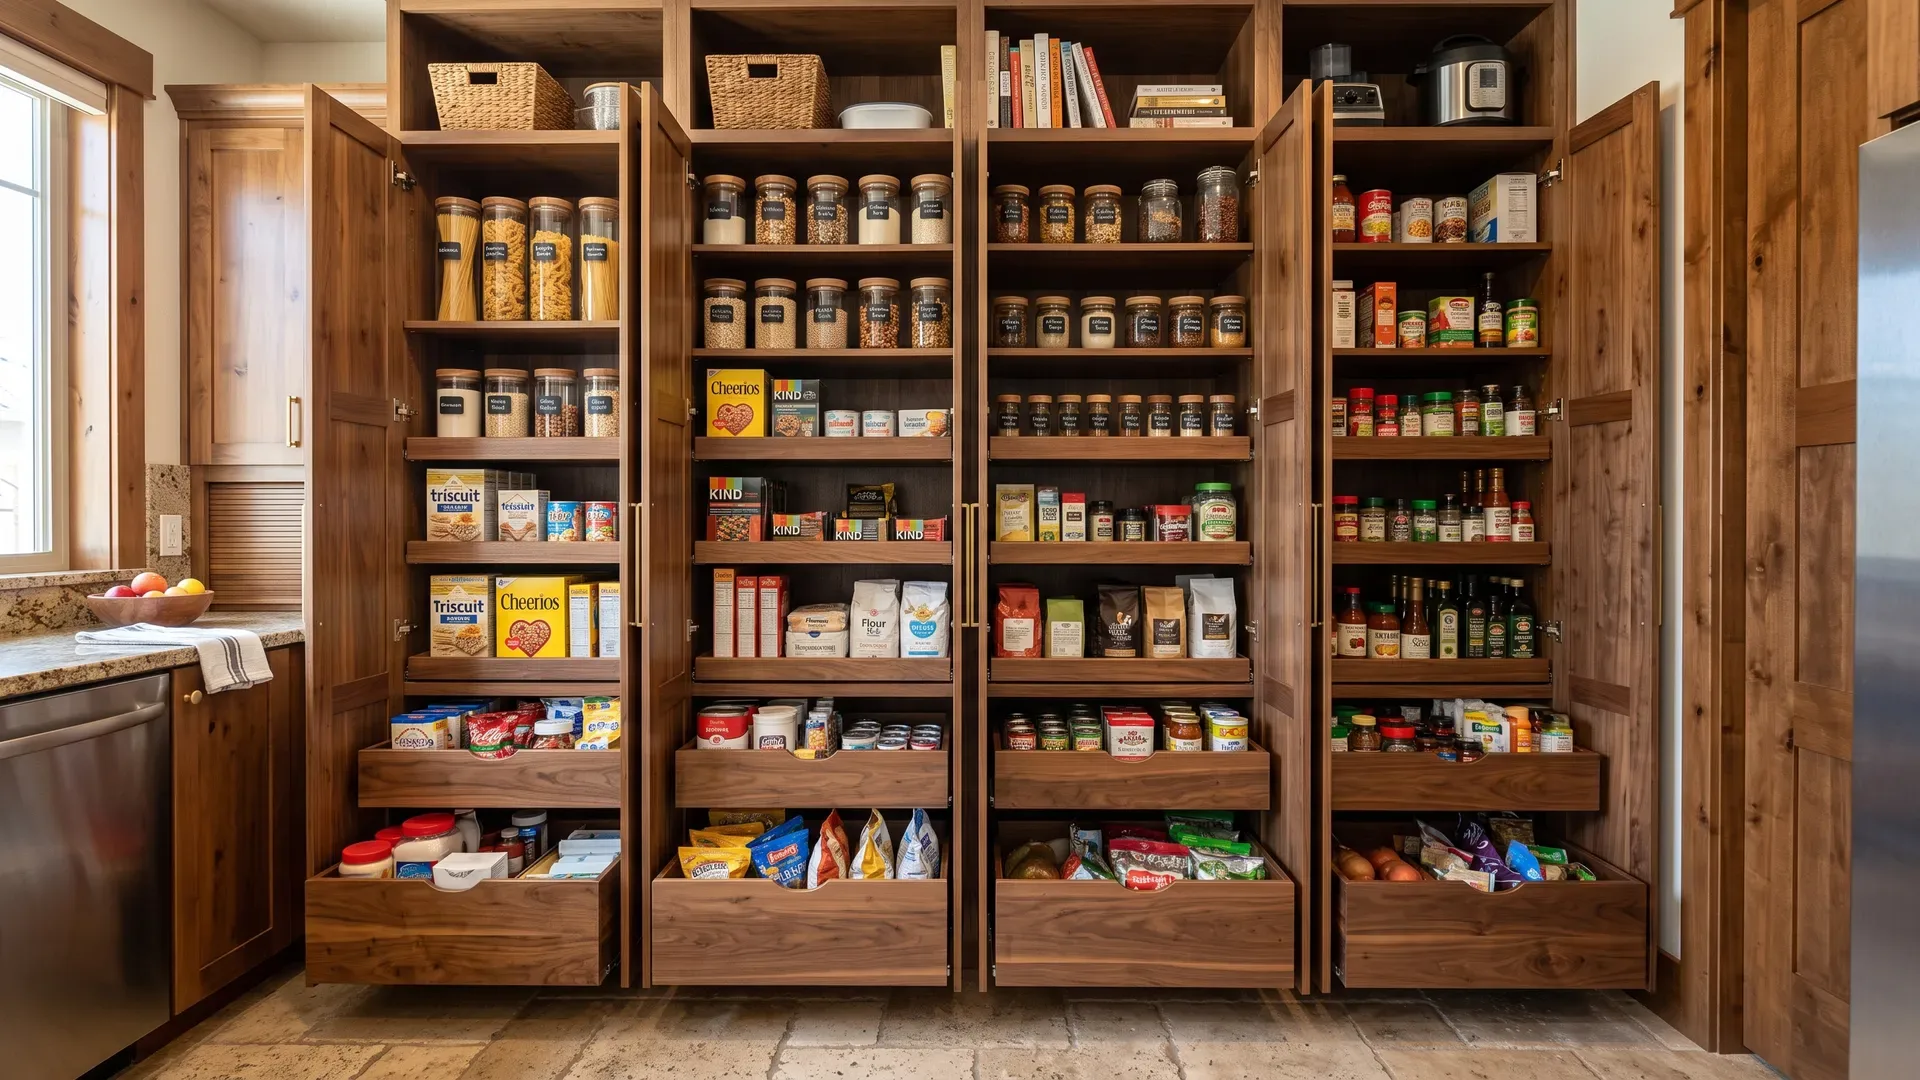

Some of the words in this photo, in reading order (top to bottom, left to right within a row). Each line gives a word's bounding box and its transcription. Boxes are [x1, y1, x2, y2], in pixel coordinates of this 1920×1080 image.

[711, 381, 760, 395] Cheerios
[774, 391, 802, 400] KIND
[430, 489, 480, 502] triscuit
[709, 489, 743, 500] KIND
[773, 525, 800, 535] KIND
[896, 530, 924, 540] KIND
[835, 531, 862, 541] KIND
[433, 600, 484, 613] Triscuit
[500, 593, 560, 610] Cheerios
[862, 619, 887, 628] Flour
